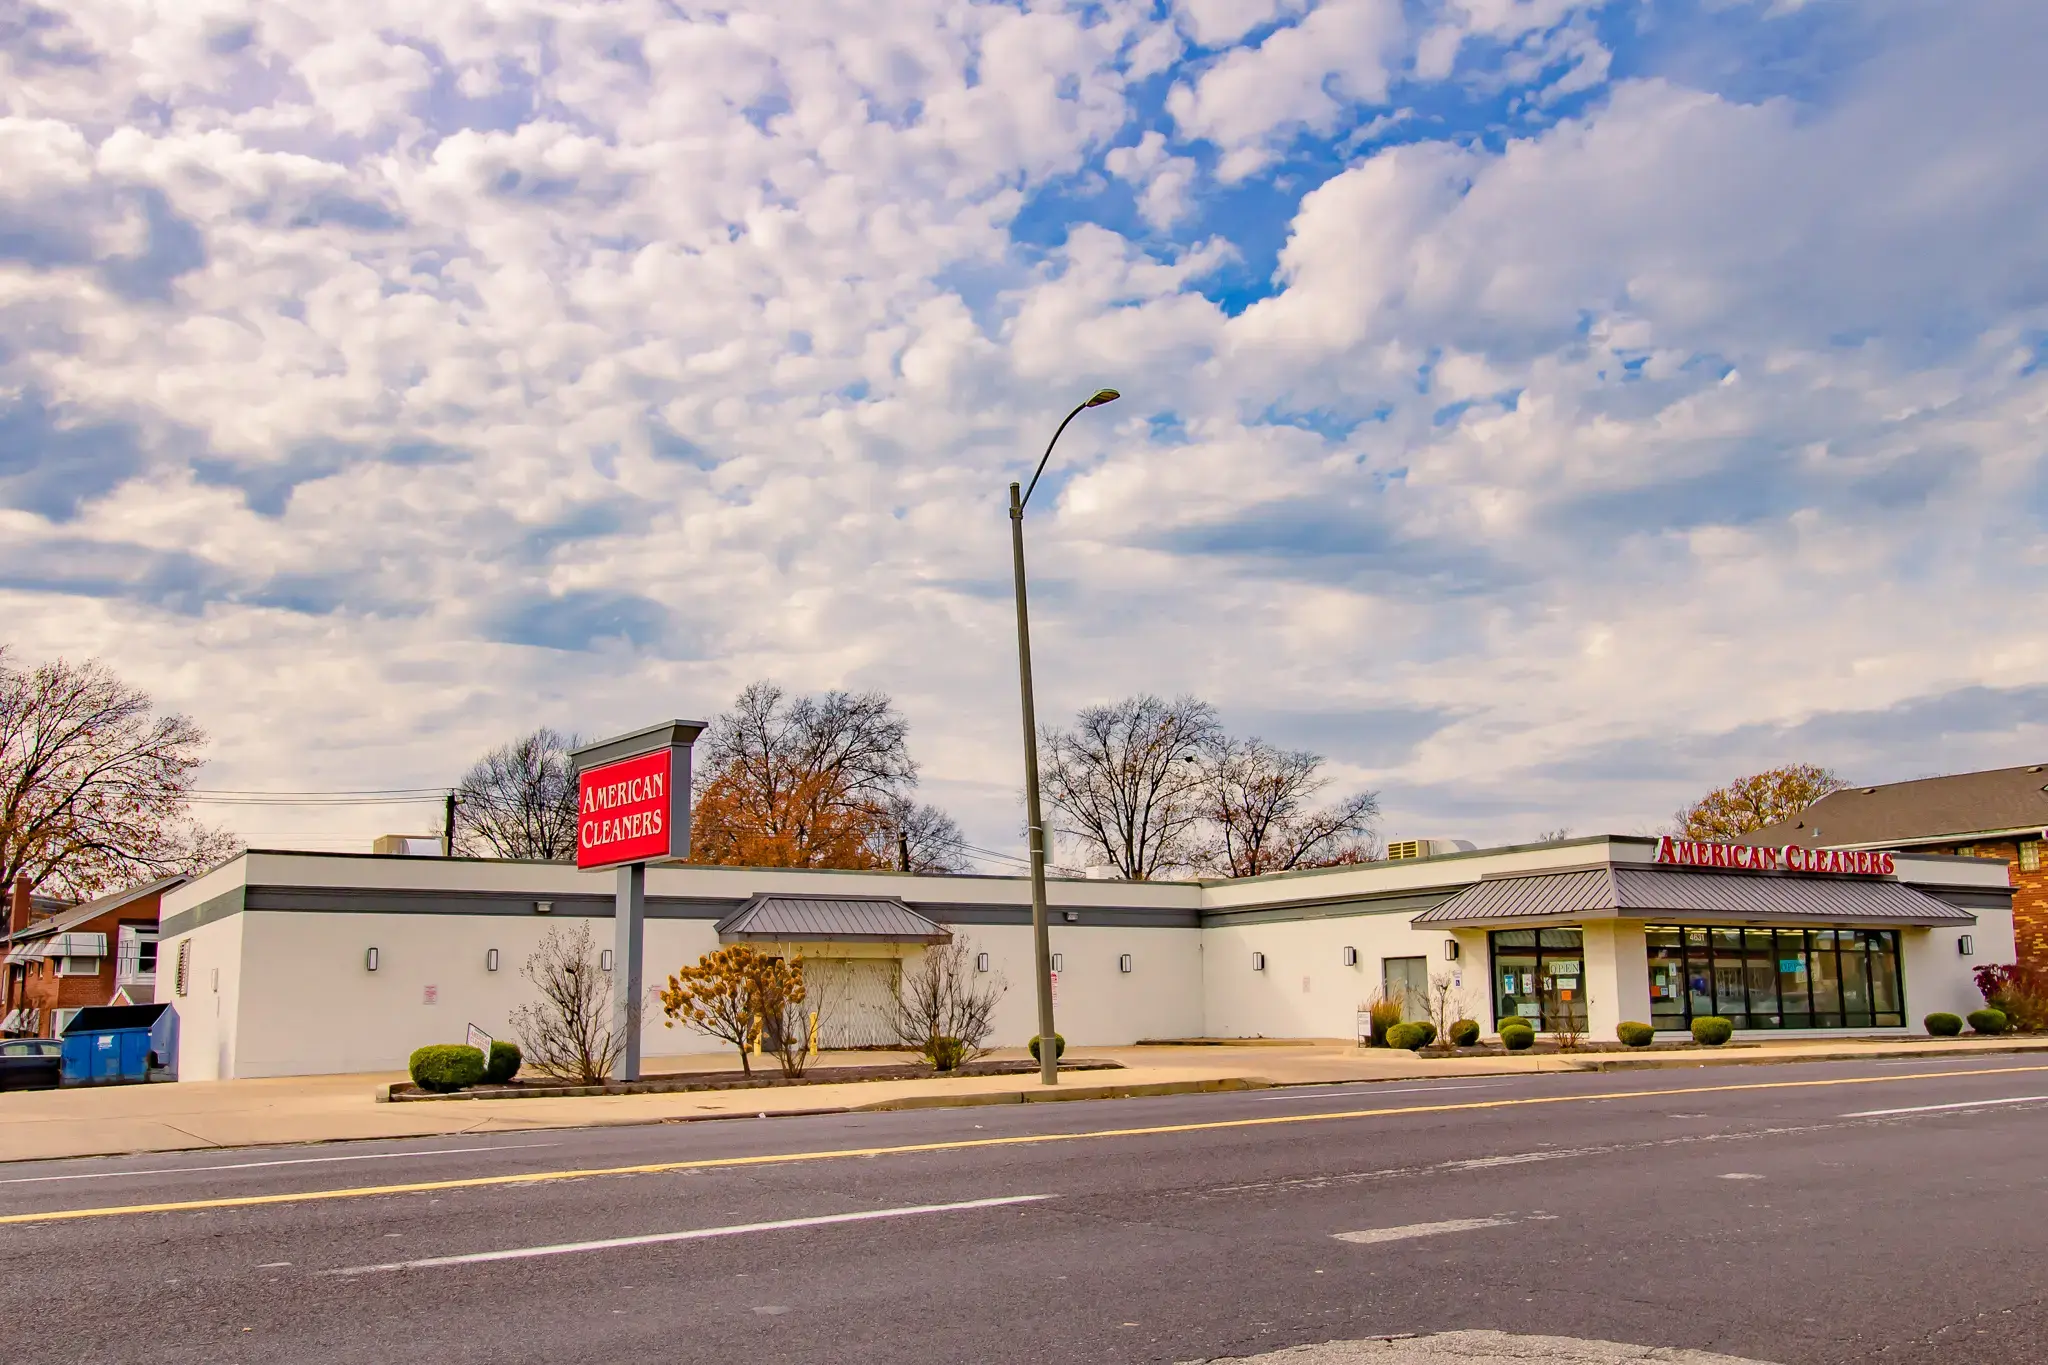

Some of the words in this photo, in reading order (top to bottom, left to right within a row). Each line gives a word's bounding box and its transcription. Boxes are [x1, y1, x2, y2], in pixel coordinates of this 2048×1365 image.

[582, 772, 664, 815] AMERICAN
[581, 808, 663, 849] CLEANERS
[1656, 835, 1778, 870] AMERICAN
[1782, 844, 1895, 875] CLEANERS
[1689, 933, 1705, 941] 4631
[1550, 963, 1579, 974] OPEN
